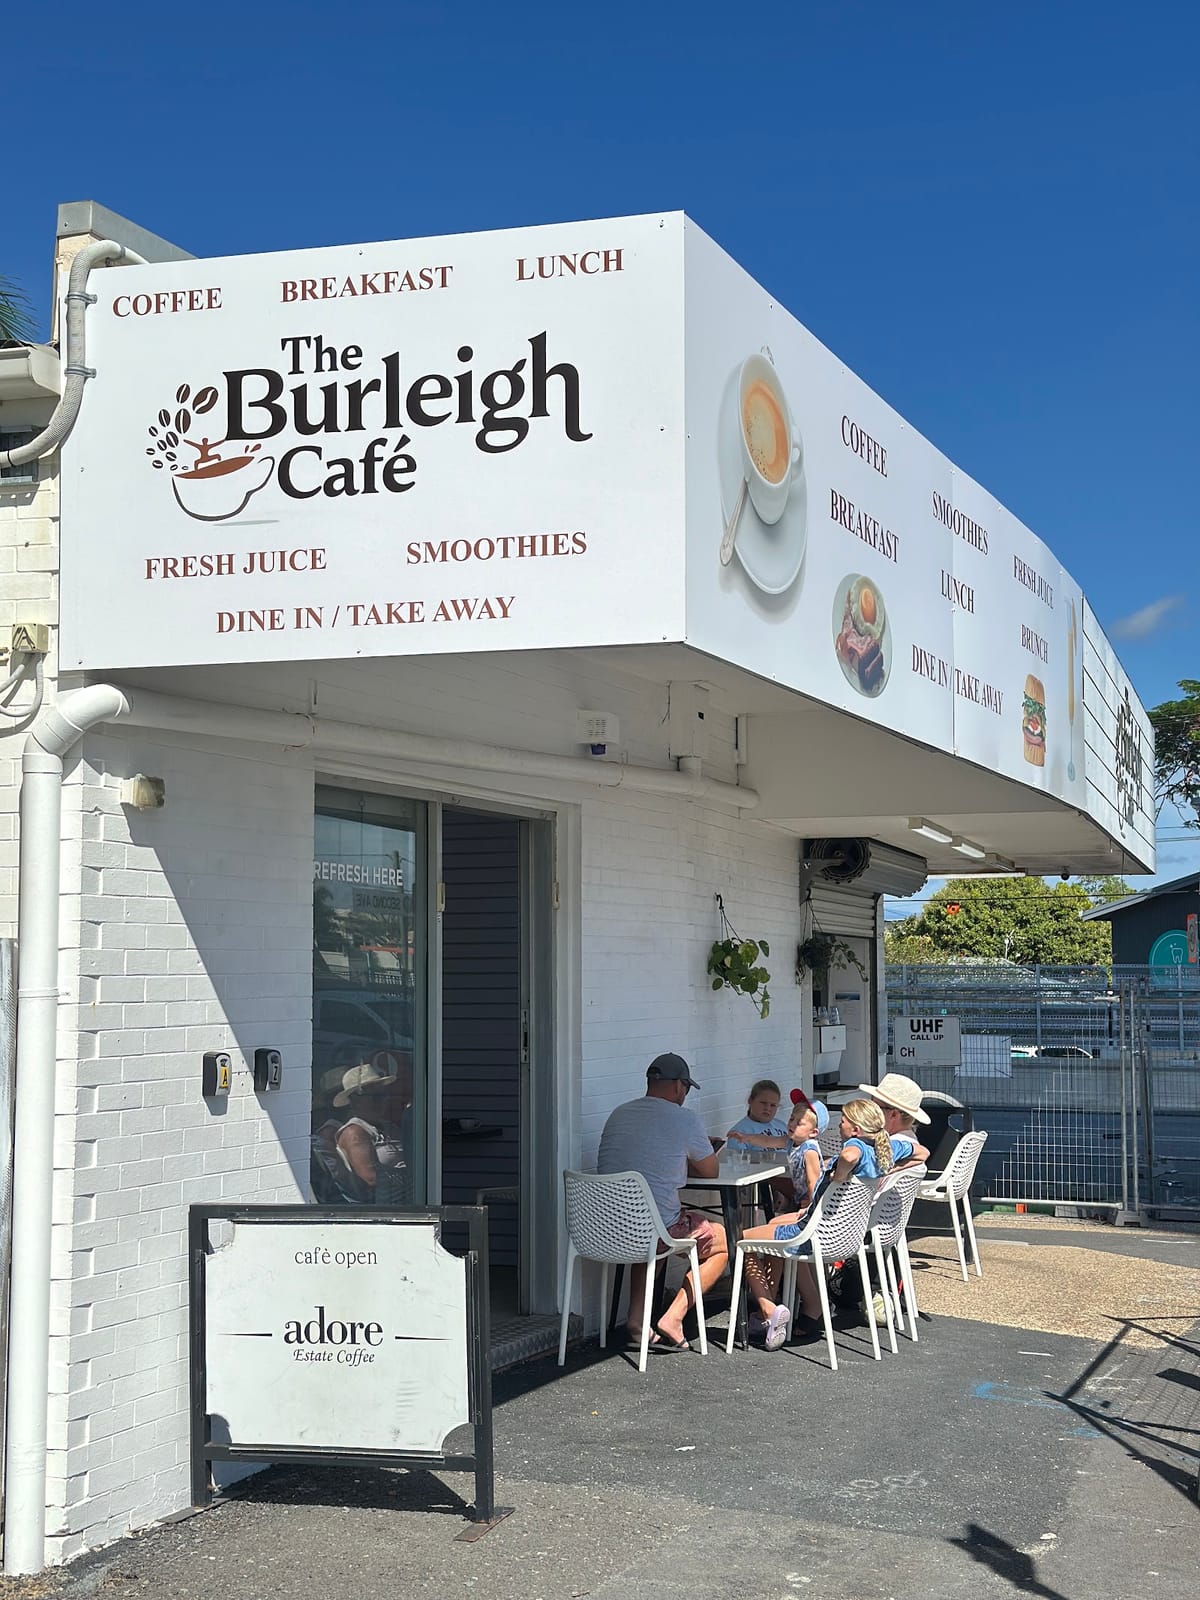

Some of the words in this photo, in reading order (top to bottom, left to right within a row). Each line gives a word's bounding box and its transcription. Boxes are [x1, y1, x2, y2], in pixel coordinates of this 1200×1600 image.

[281, 266, 454, 303] BREAKFAST
[517, 249, 624, 281] LUNCH
[112, 287, 223, 318] COFFEE
[281, 334, 363, 375] The
[222, 331, 593, 453] Burleigh
[841, 415, 888, 478] COFFEE
[277, 434, 417, 499] Café
[830, 488, 899, 563] BREAKFAST
[932, 491, 989, 555] SMOOTHIES
[146, 553, 235, 580] FRESH
[242, 548, 327, 575] JUICE
[406, 532, 587, 565] SMOOTHIES
[941, 569, 975, 614] LUNCH
[1014, 555, 1036, 594] FRESH
[1037, 575, 1054, 610] JUICE
[217, 609, 285, 634] DINE
[294, 606, 324, 630] IN
[331, 605, 340, 628] /
[346, 601, 426, 627] TAKE
[432, 596, 516, 622] AWAY
[1021, 624, 1048, 664] BRUNCH
[912, 644, 936, 682] DINE
[938, 658, 948, 688] IN
[955, 668, 980, 704] TAKE
[981, 683, 1004, 715] AWAY
[312, 861, 368, 883] REFRESH
[373, 867, 404, 886] HERE
[910, 1019, 944, 1033] UHF
[900, 1046, 915, 1058] CH
[335, 1251, 378, 1269] open
[283, 1306, 384, 1346] adore
[293, 1349, 334, 1362] Estate
[336, 1348, 376, 1367] Coffee
